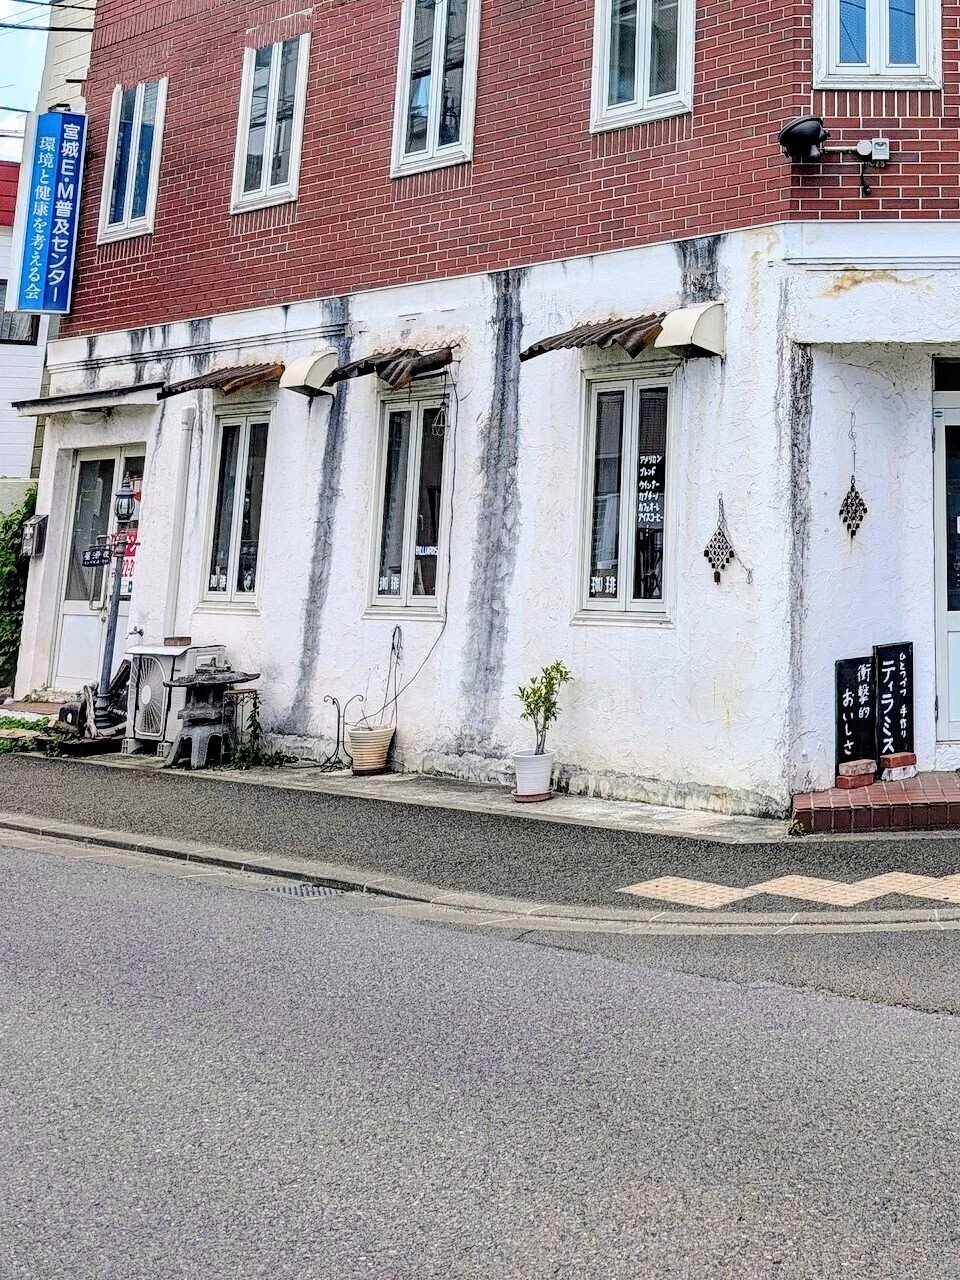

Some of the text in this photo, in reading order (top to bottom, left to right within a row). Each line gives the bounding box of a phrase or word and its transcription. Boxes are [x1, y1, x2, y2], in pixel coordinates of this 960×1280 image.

[25, 136, 56, 300] 環境と健康を考える会
[639, 455, 662, 464] アメリカン
[639, 466, 656, 476] ブレンド
[590, 576, 617, 594] 珈琲
[857, 664, 871, 719] 衝撃的
[881, 660, 896, 754] ティラミス
[842, 688, 855, 756] おいしさ
